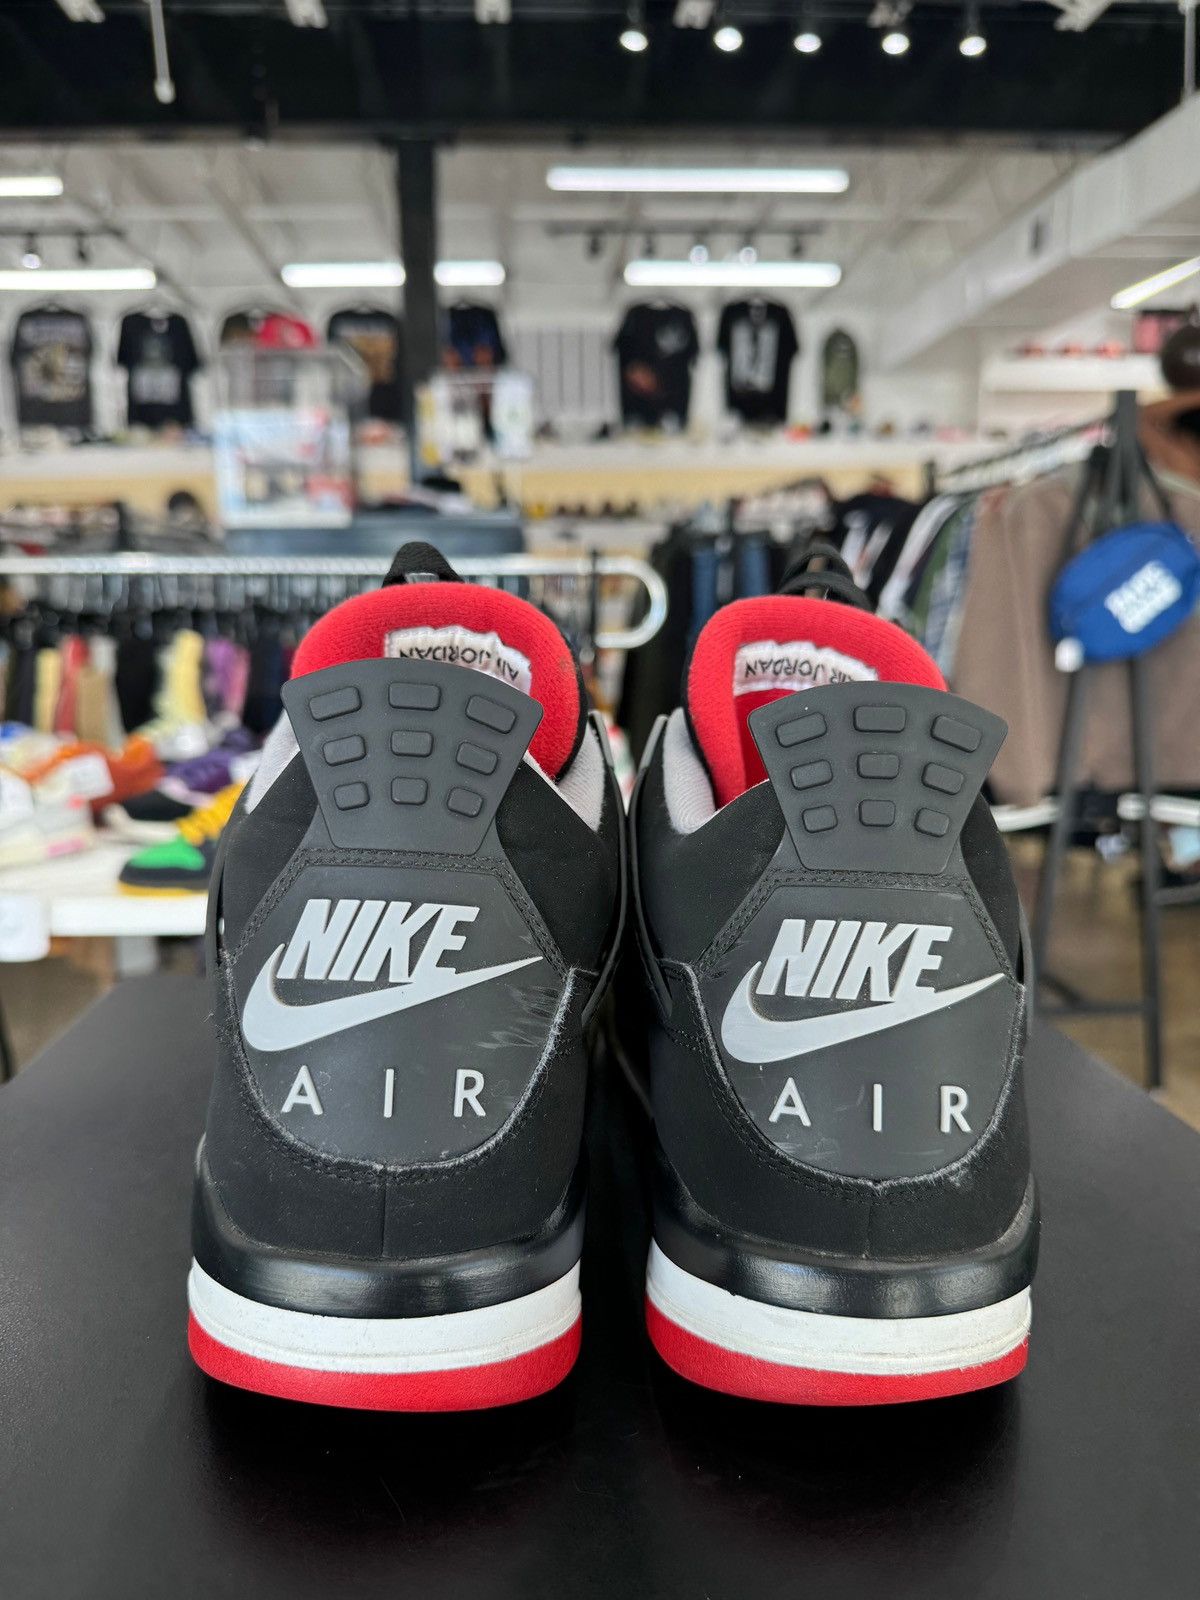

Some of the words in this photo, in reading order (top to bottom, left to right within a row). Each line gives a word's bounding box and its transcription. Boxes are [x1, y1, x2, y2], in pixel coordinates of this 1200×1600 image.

[744, 657, 824, 681] JORDAN
[276, 898, 480, 984] NIKE
[756, 918, 953, 1002] NIKE
[281, 1064, 486, 1118] AIR
[768, 1077, 972, 1133] AIR
